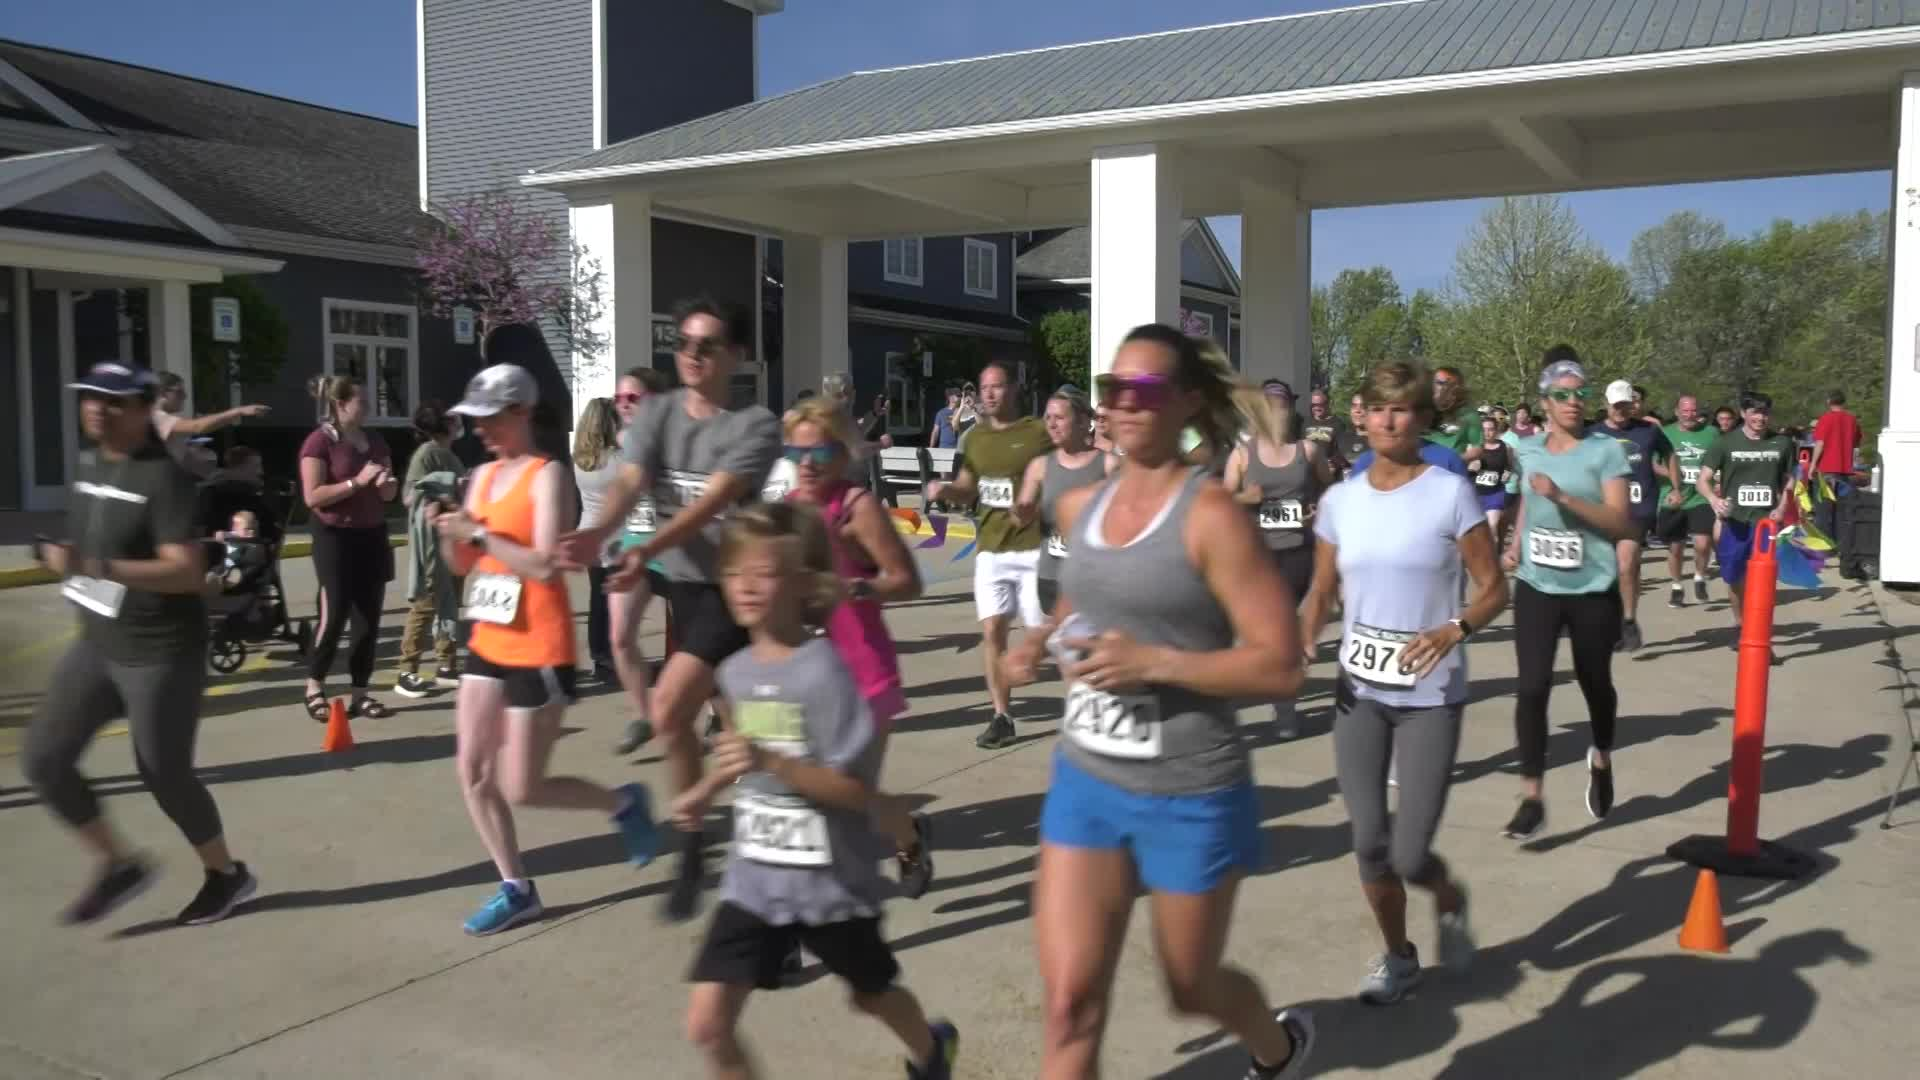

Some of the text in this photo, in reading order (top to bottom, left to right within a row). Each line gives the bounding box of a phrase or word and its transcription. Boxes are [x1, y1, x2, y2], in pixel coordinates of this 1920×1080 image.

[1741, 491, 1770, 502] 3018
[1262, 507, 1299, 524] 2961
[1531, 537, 1578, 560] 3056
[1348, 639, 1411, 676] 297
